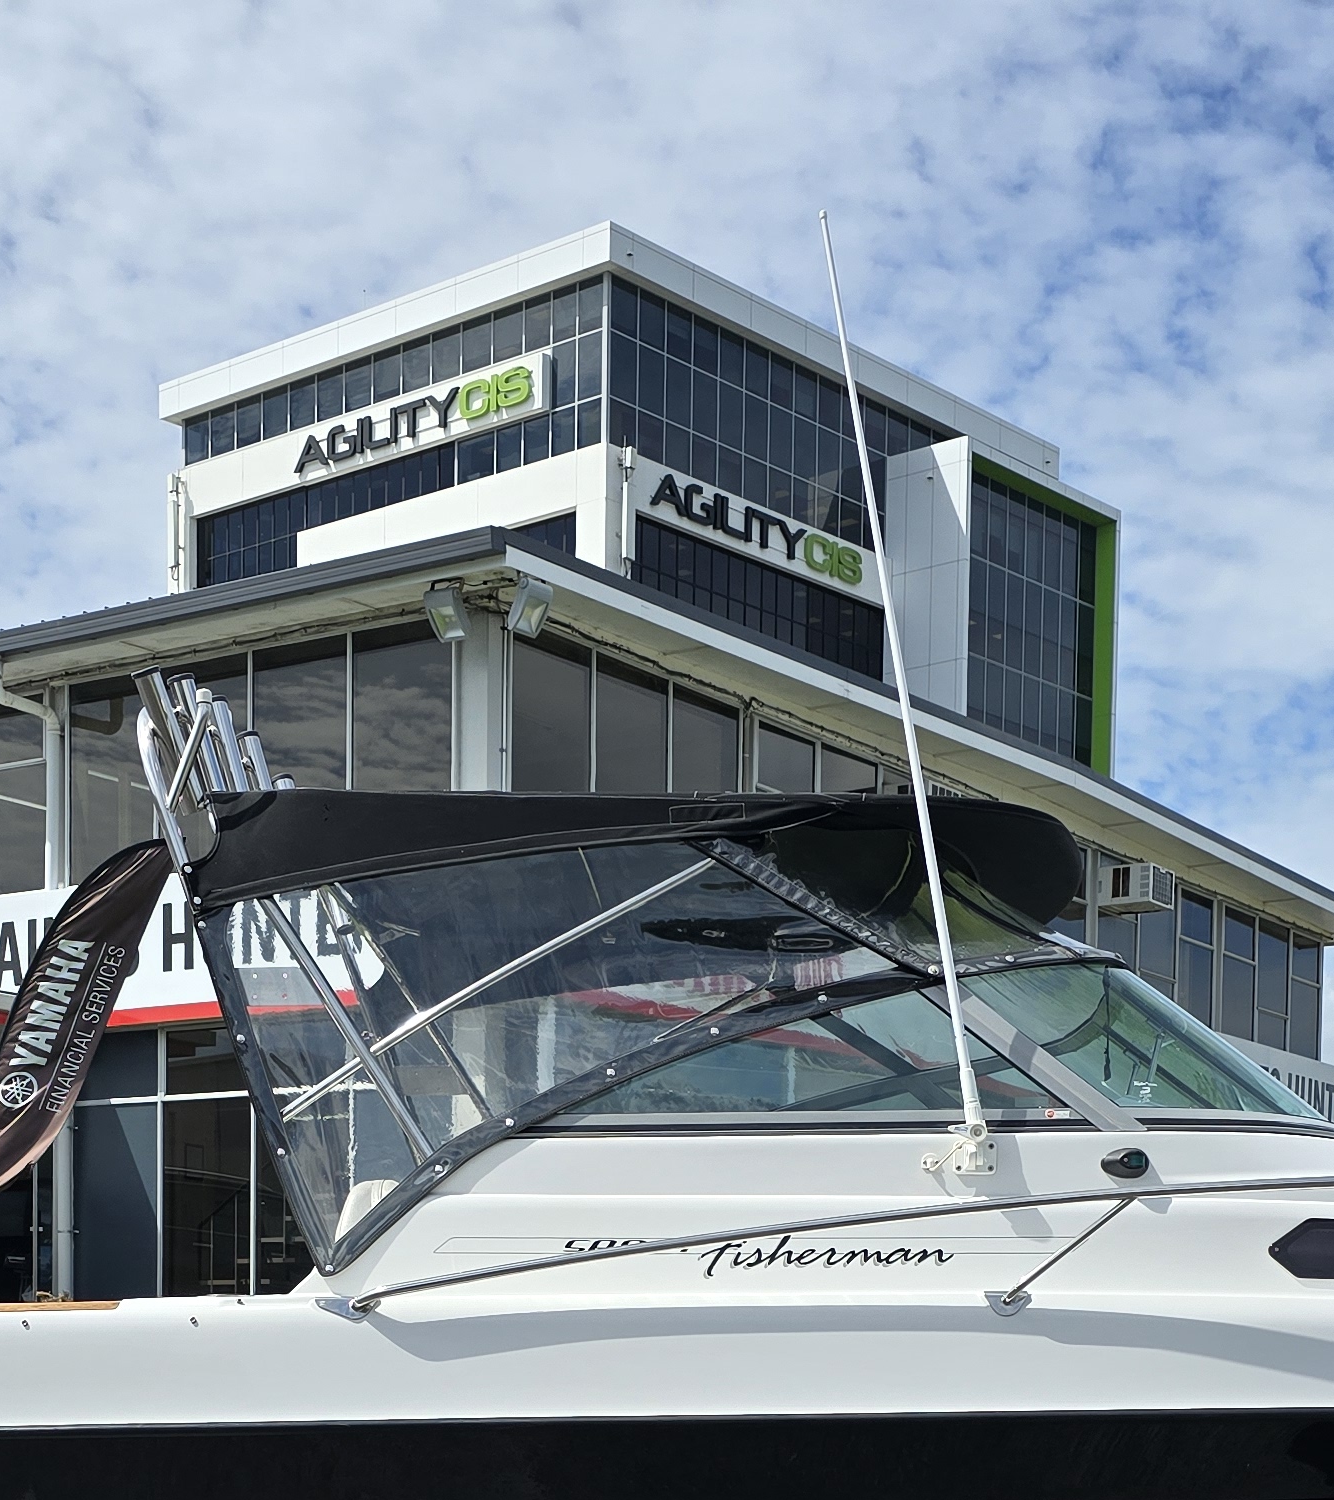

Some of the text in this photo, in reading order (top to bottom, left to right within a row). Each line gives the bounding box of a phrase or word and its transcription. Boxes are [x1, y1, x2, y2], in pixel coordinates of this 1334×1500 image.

[8, 938, 96, 1068] YAMAHA
[44, 944, 127, 1115] FINANCIAL SERVICES
[699, 1235, 955, 1279] Fisherman
